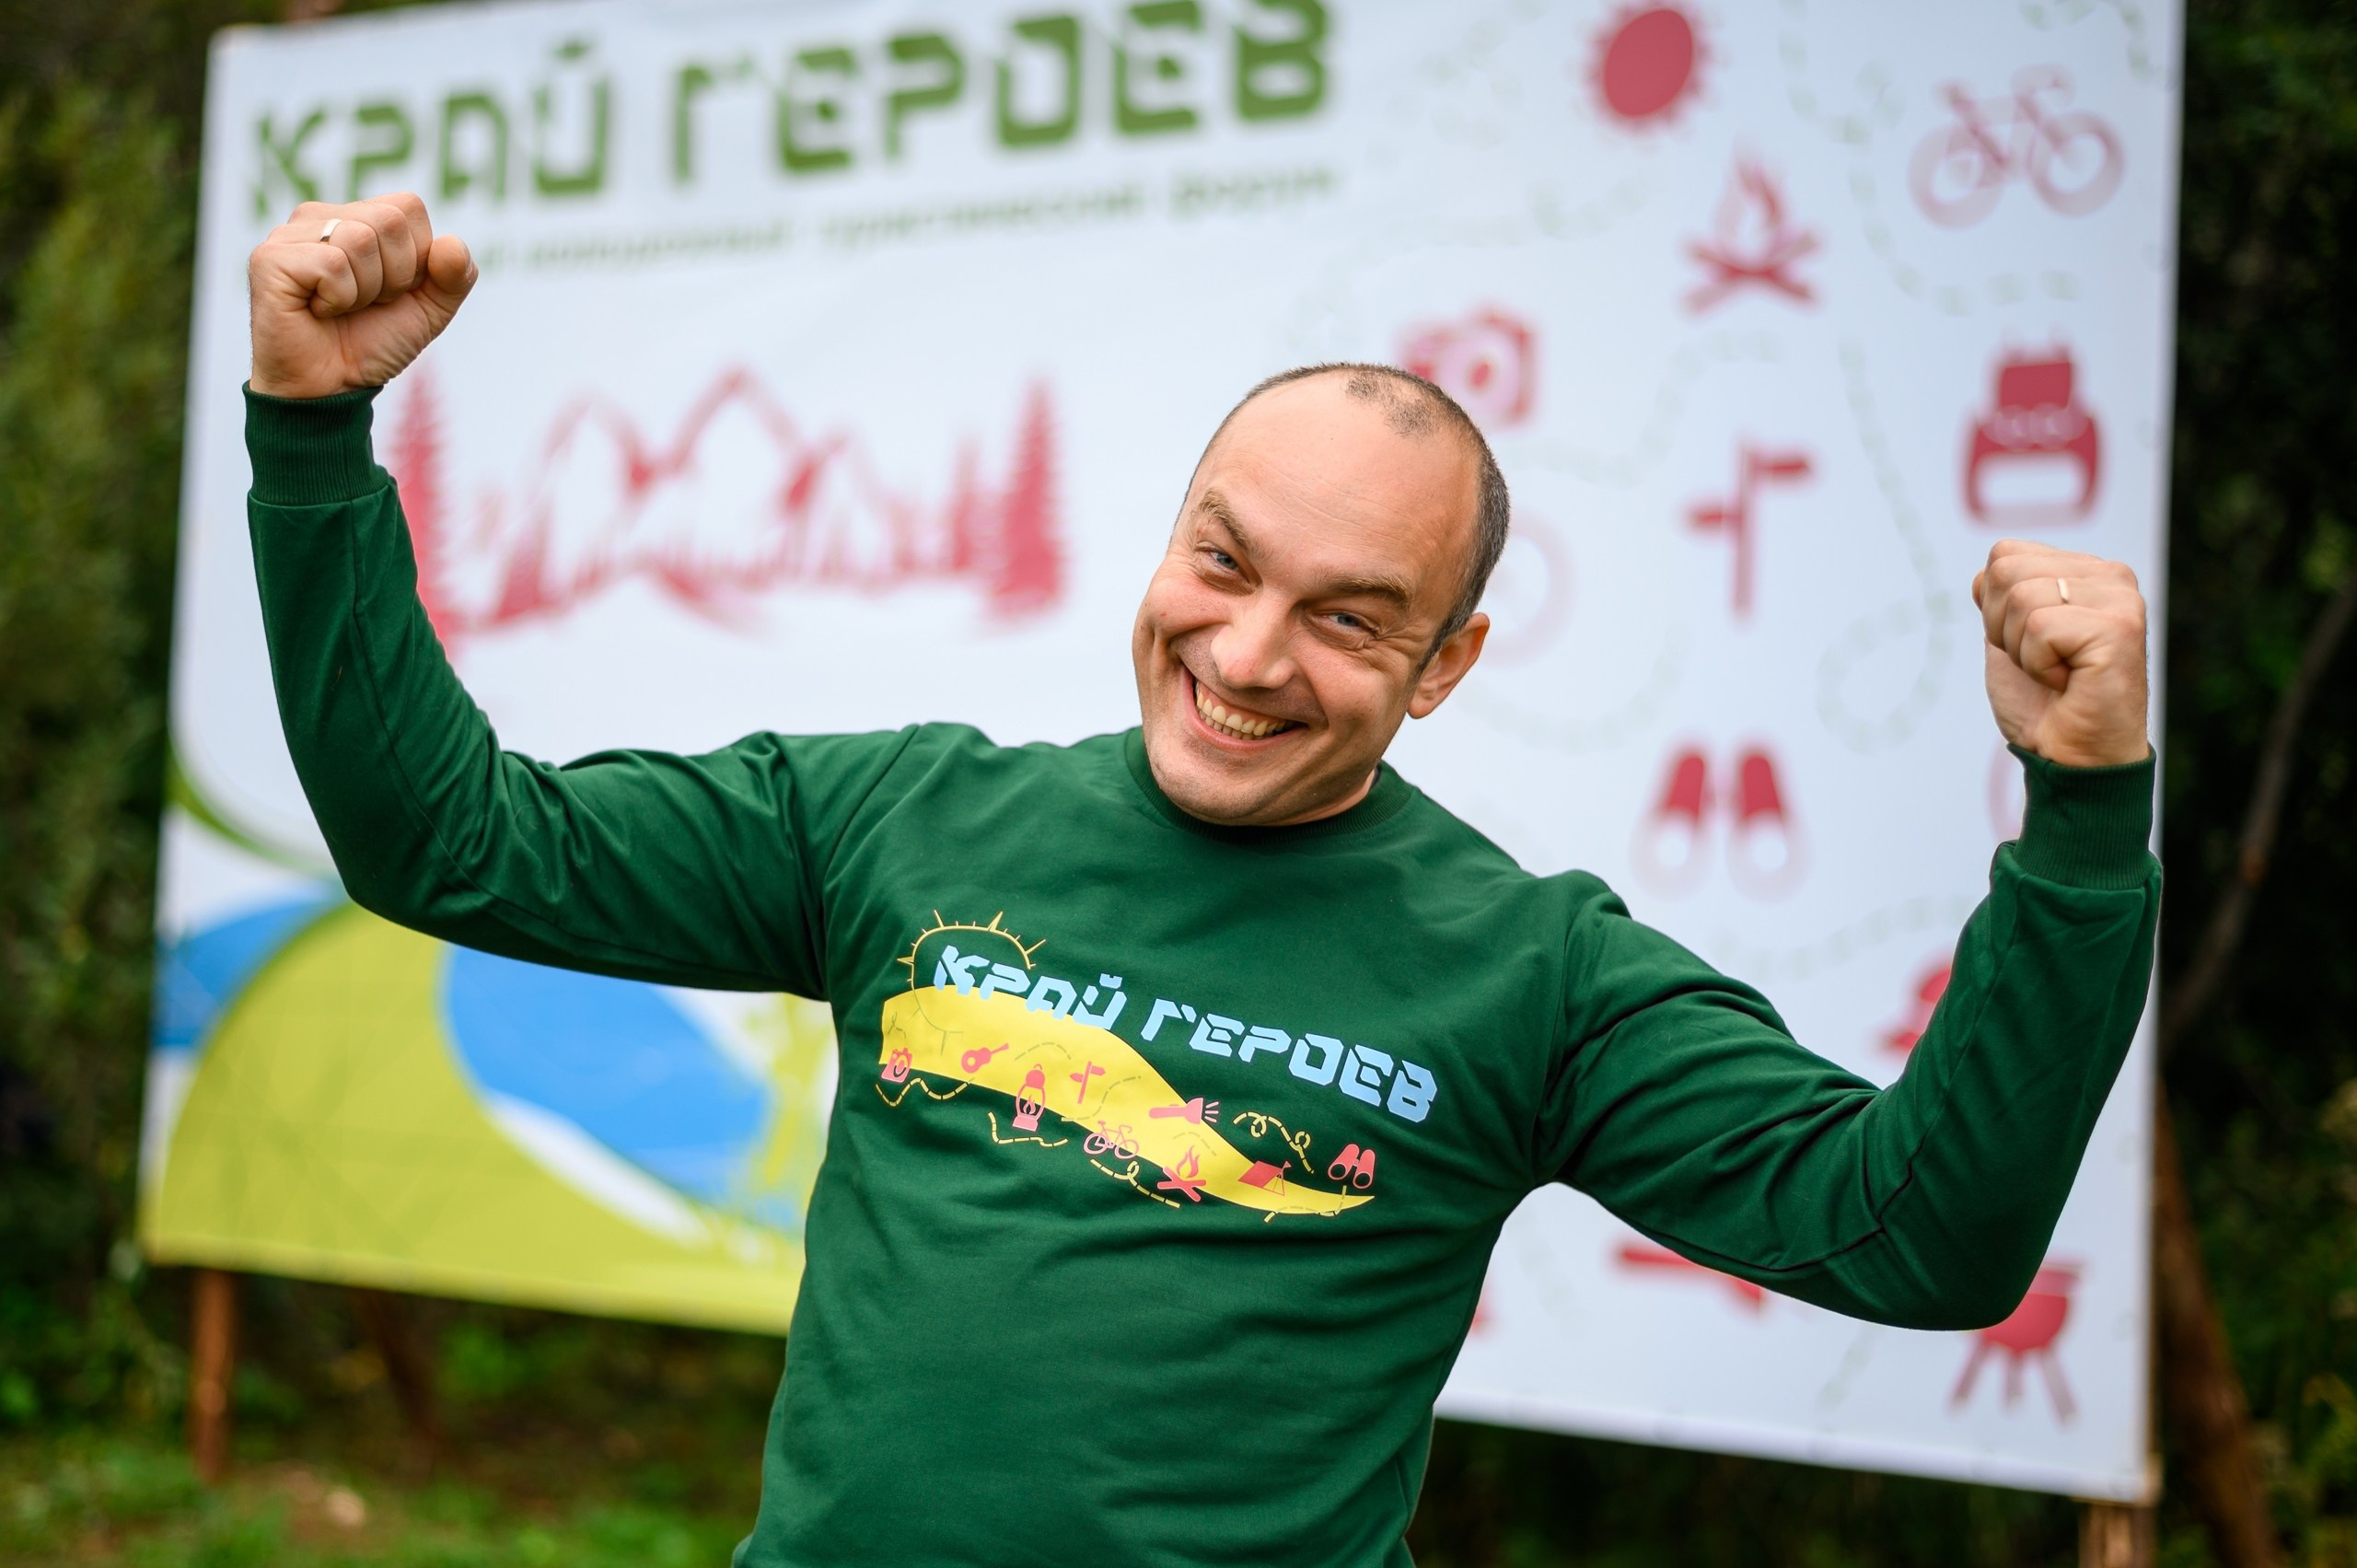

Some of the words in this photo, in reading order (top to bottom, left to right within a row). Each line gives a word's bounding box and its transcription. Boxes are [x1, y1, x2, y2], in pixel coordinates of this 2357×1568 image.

[253, 37, 611, 219] КРАЙ
[672, 0, 1333, 185] ГЕРОЕВ
[933, 944, 1128, 1031] КРАЙ
[1140, 997, 1438, 1123] ГЕРОЕВ
